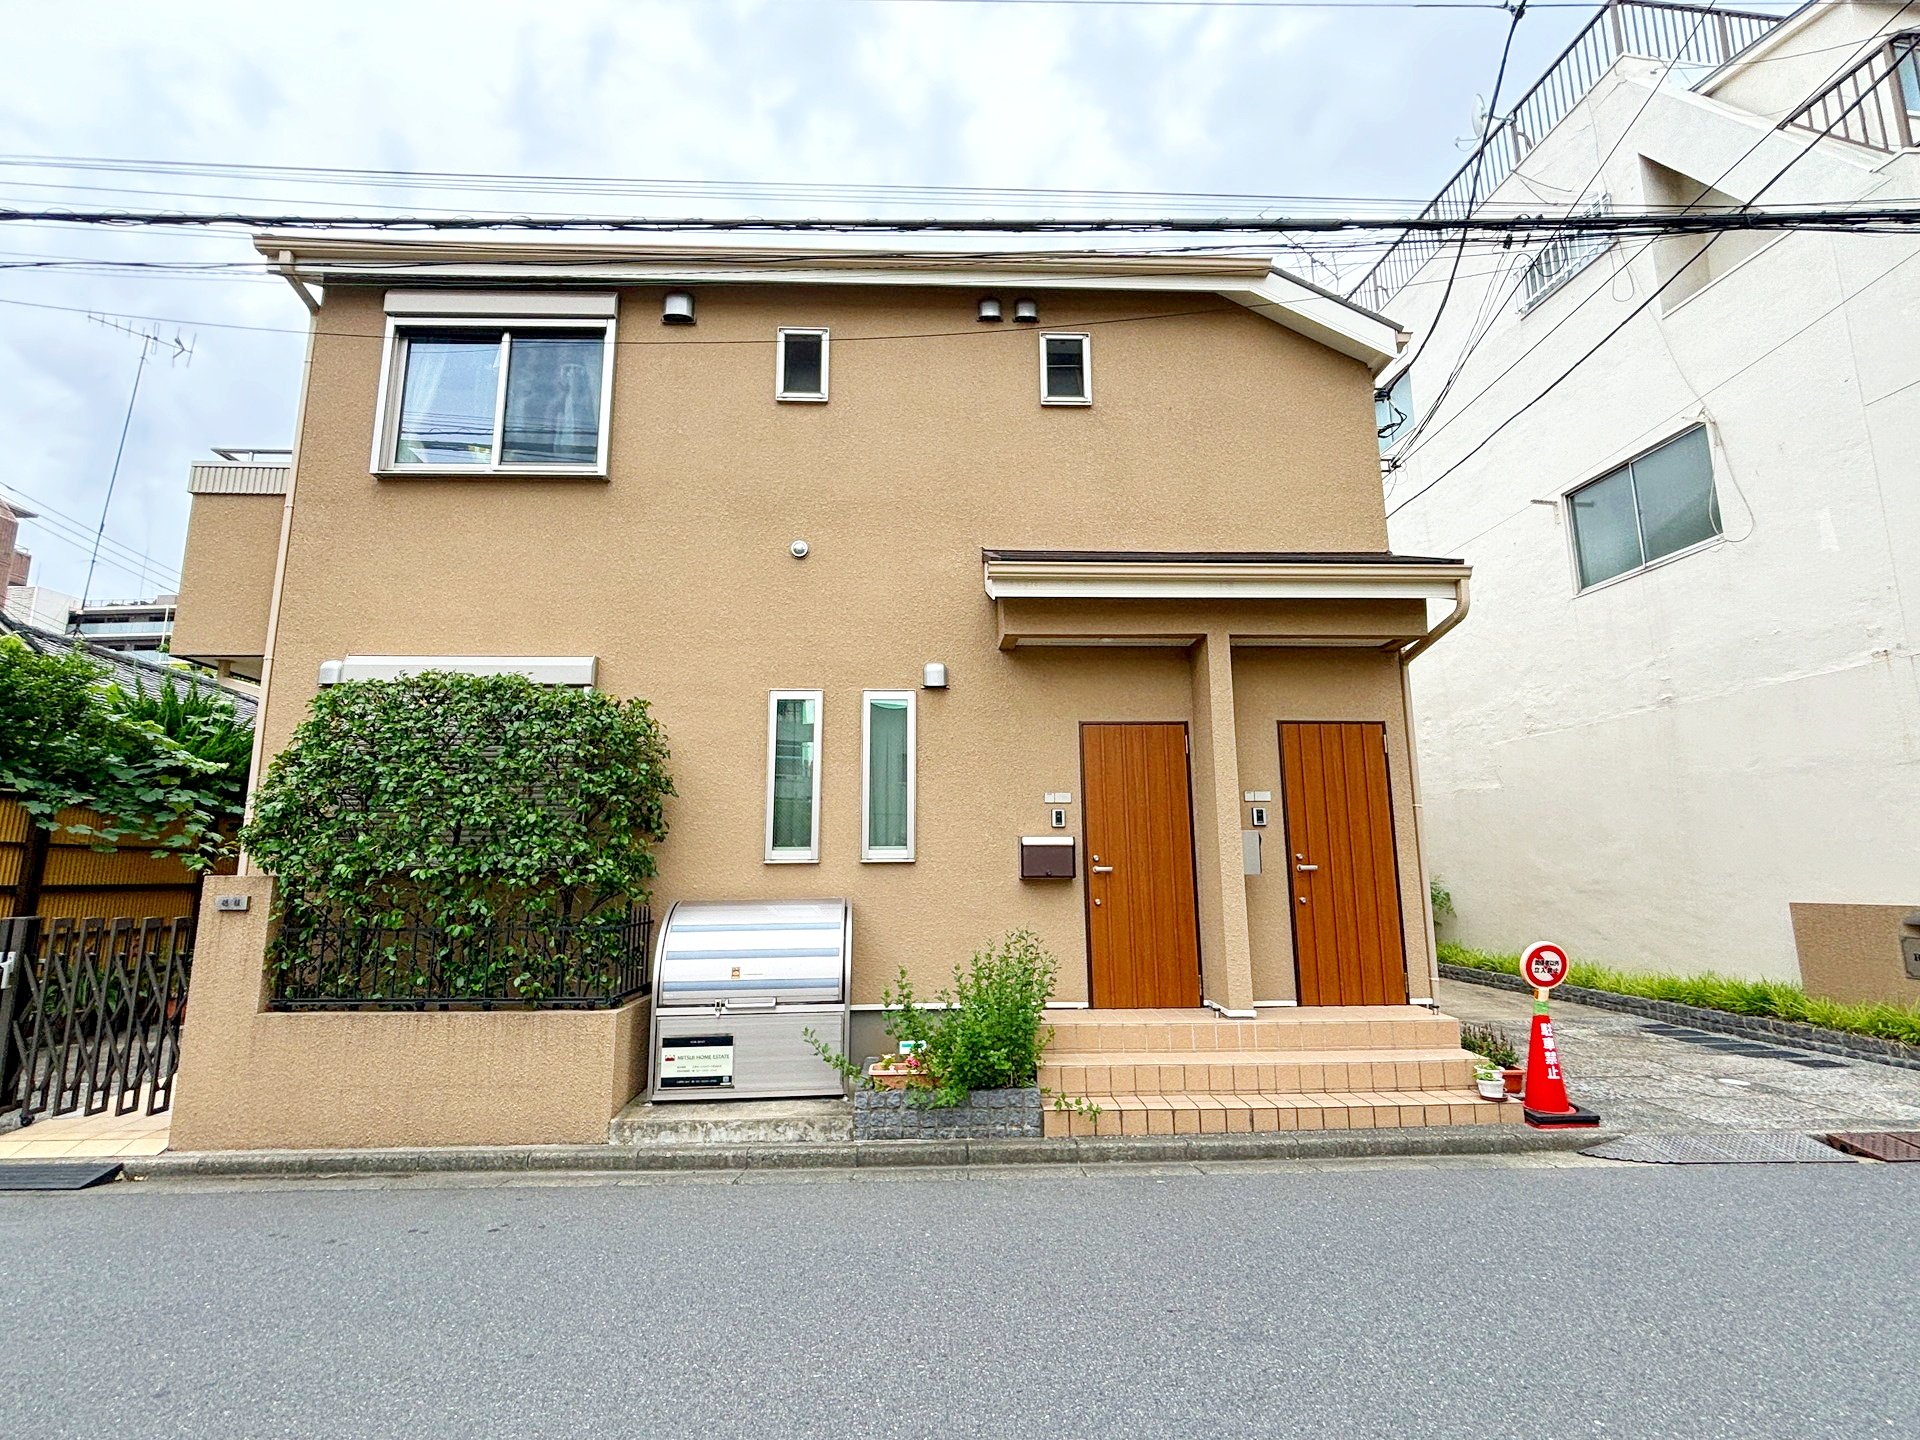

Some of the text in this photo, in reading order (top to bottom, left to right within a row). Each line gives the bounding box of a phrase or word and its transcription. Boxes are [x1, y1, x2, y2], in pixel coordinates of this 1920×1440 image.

[1534, 967, 1559, 975] 立入禁止
[1540, 1023, 1560, 1079] 駐車禁止
